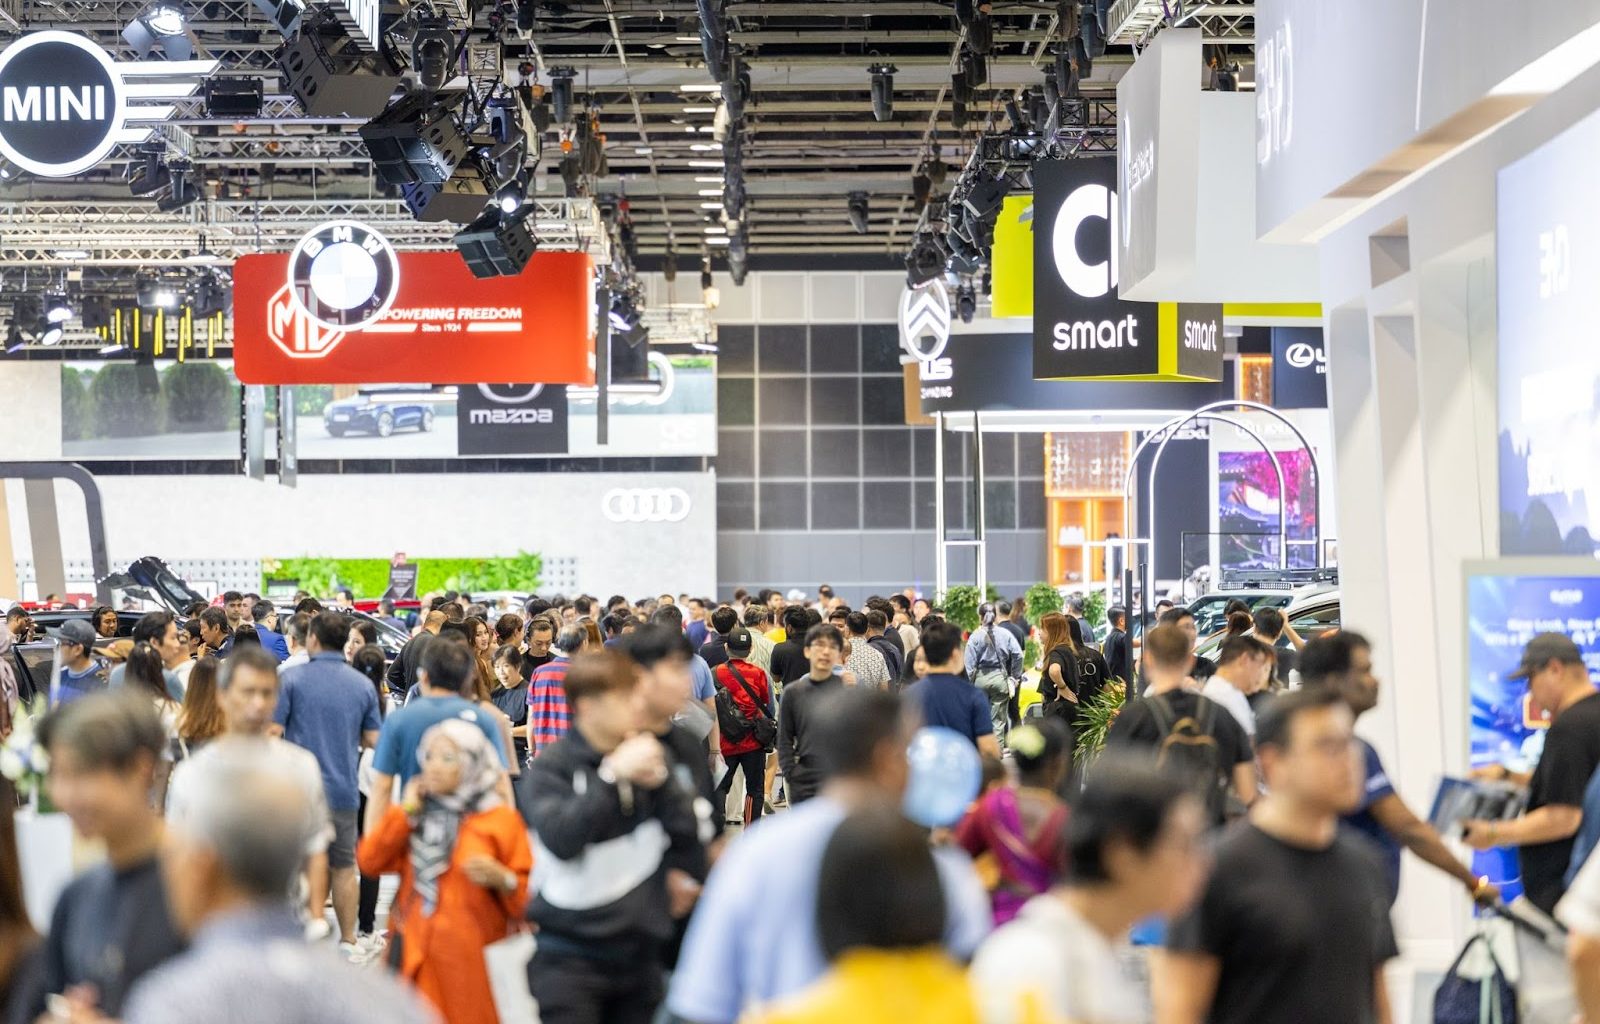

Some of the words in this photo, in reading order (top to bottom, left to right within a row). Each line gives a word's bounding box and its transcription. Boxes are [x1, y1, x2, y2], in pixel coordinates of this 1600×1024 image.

[4, 85, 105, 121] MINI
[302, 226, 385, 259] BMW
[421, 322, 442, 333] Since
[443, 322, 462, 333] 1924
[457, 307, 523, 320] FREEDOM
[1053, 314, 1138, 351] smart
[1184, 319, 1218, 353] smart
[469, 408, 554, 424] mazda
